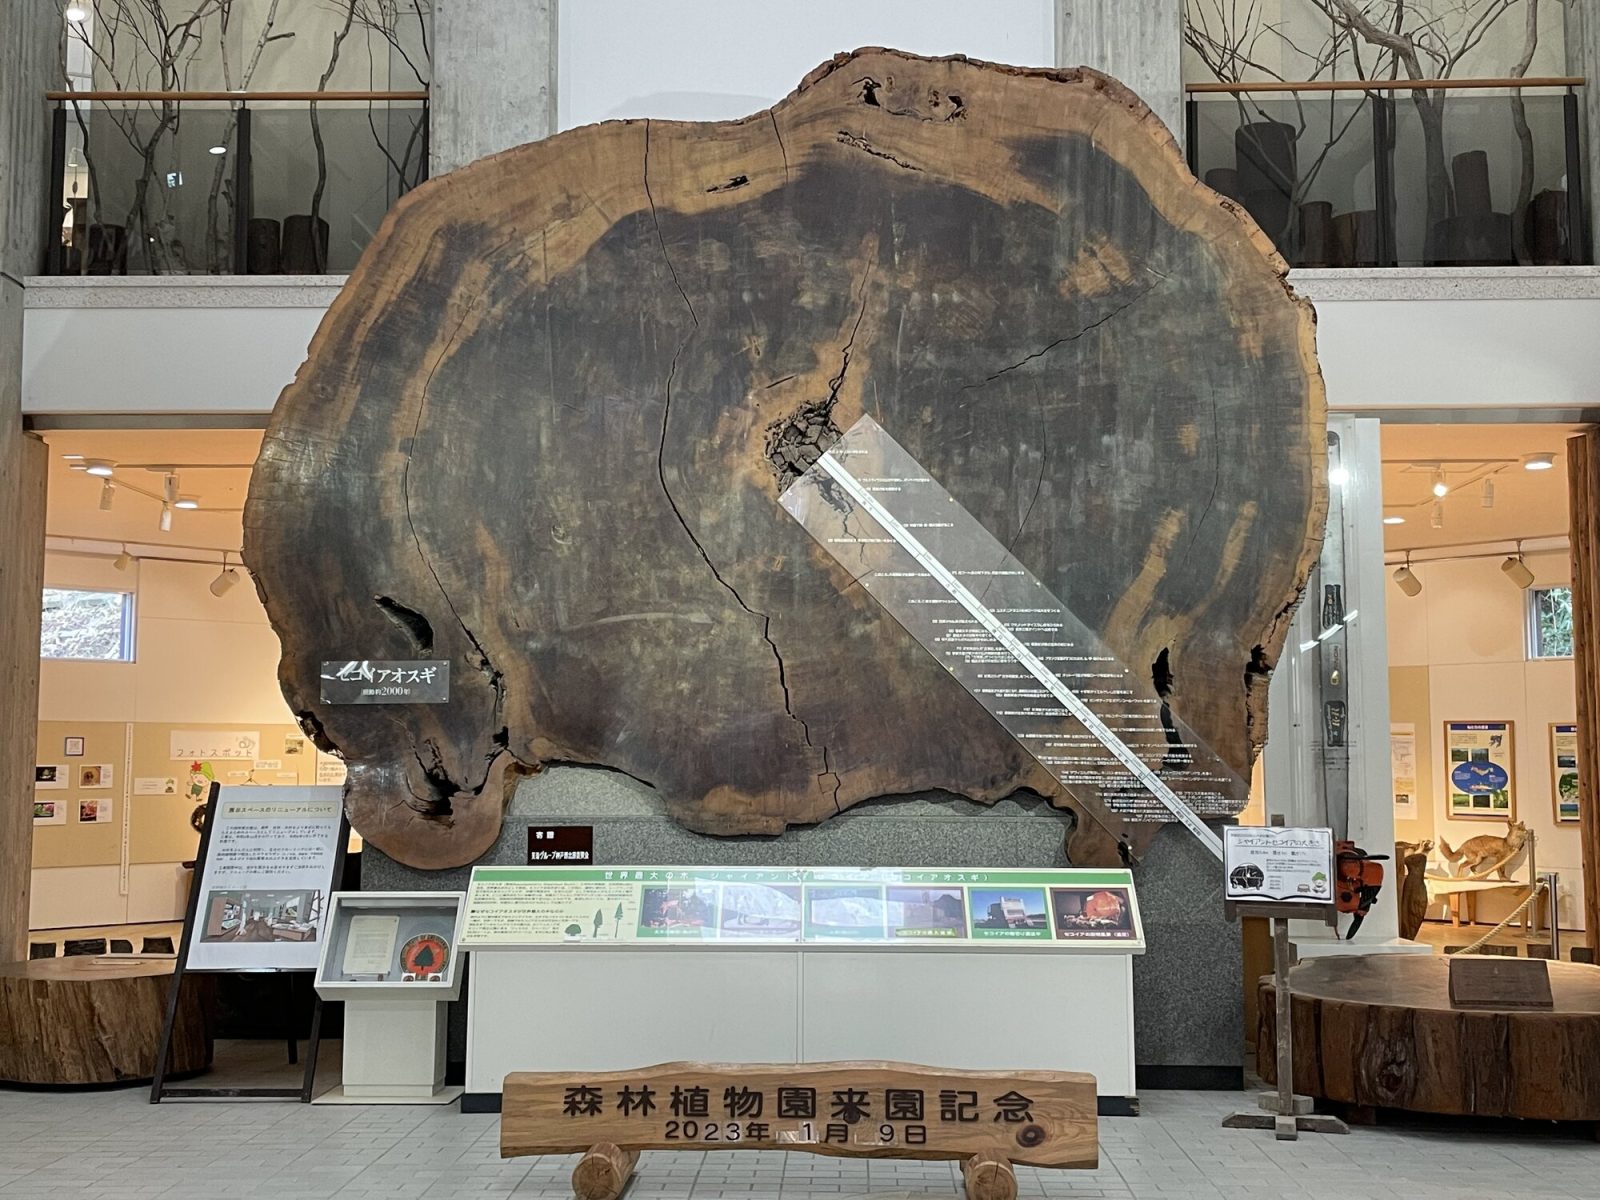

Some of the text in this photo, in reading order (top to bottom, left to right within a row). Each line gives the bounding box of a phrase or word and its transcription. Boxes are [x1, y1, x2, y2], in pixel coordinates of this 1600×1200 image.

[176, 749, 253, 758] フォトスポット
[562, 1085, 1035, 1123] 森林植物園来園記念
[664, 1121, 770, 1142] 2023年
